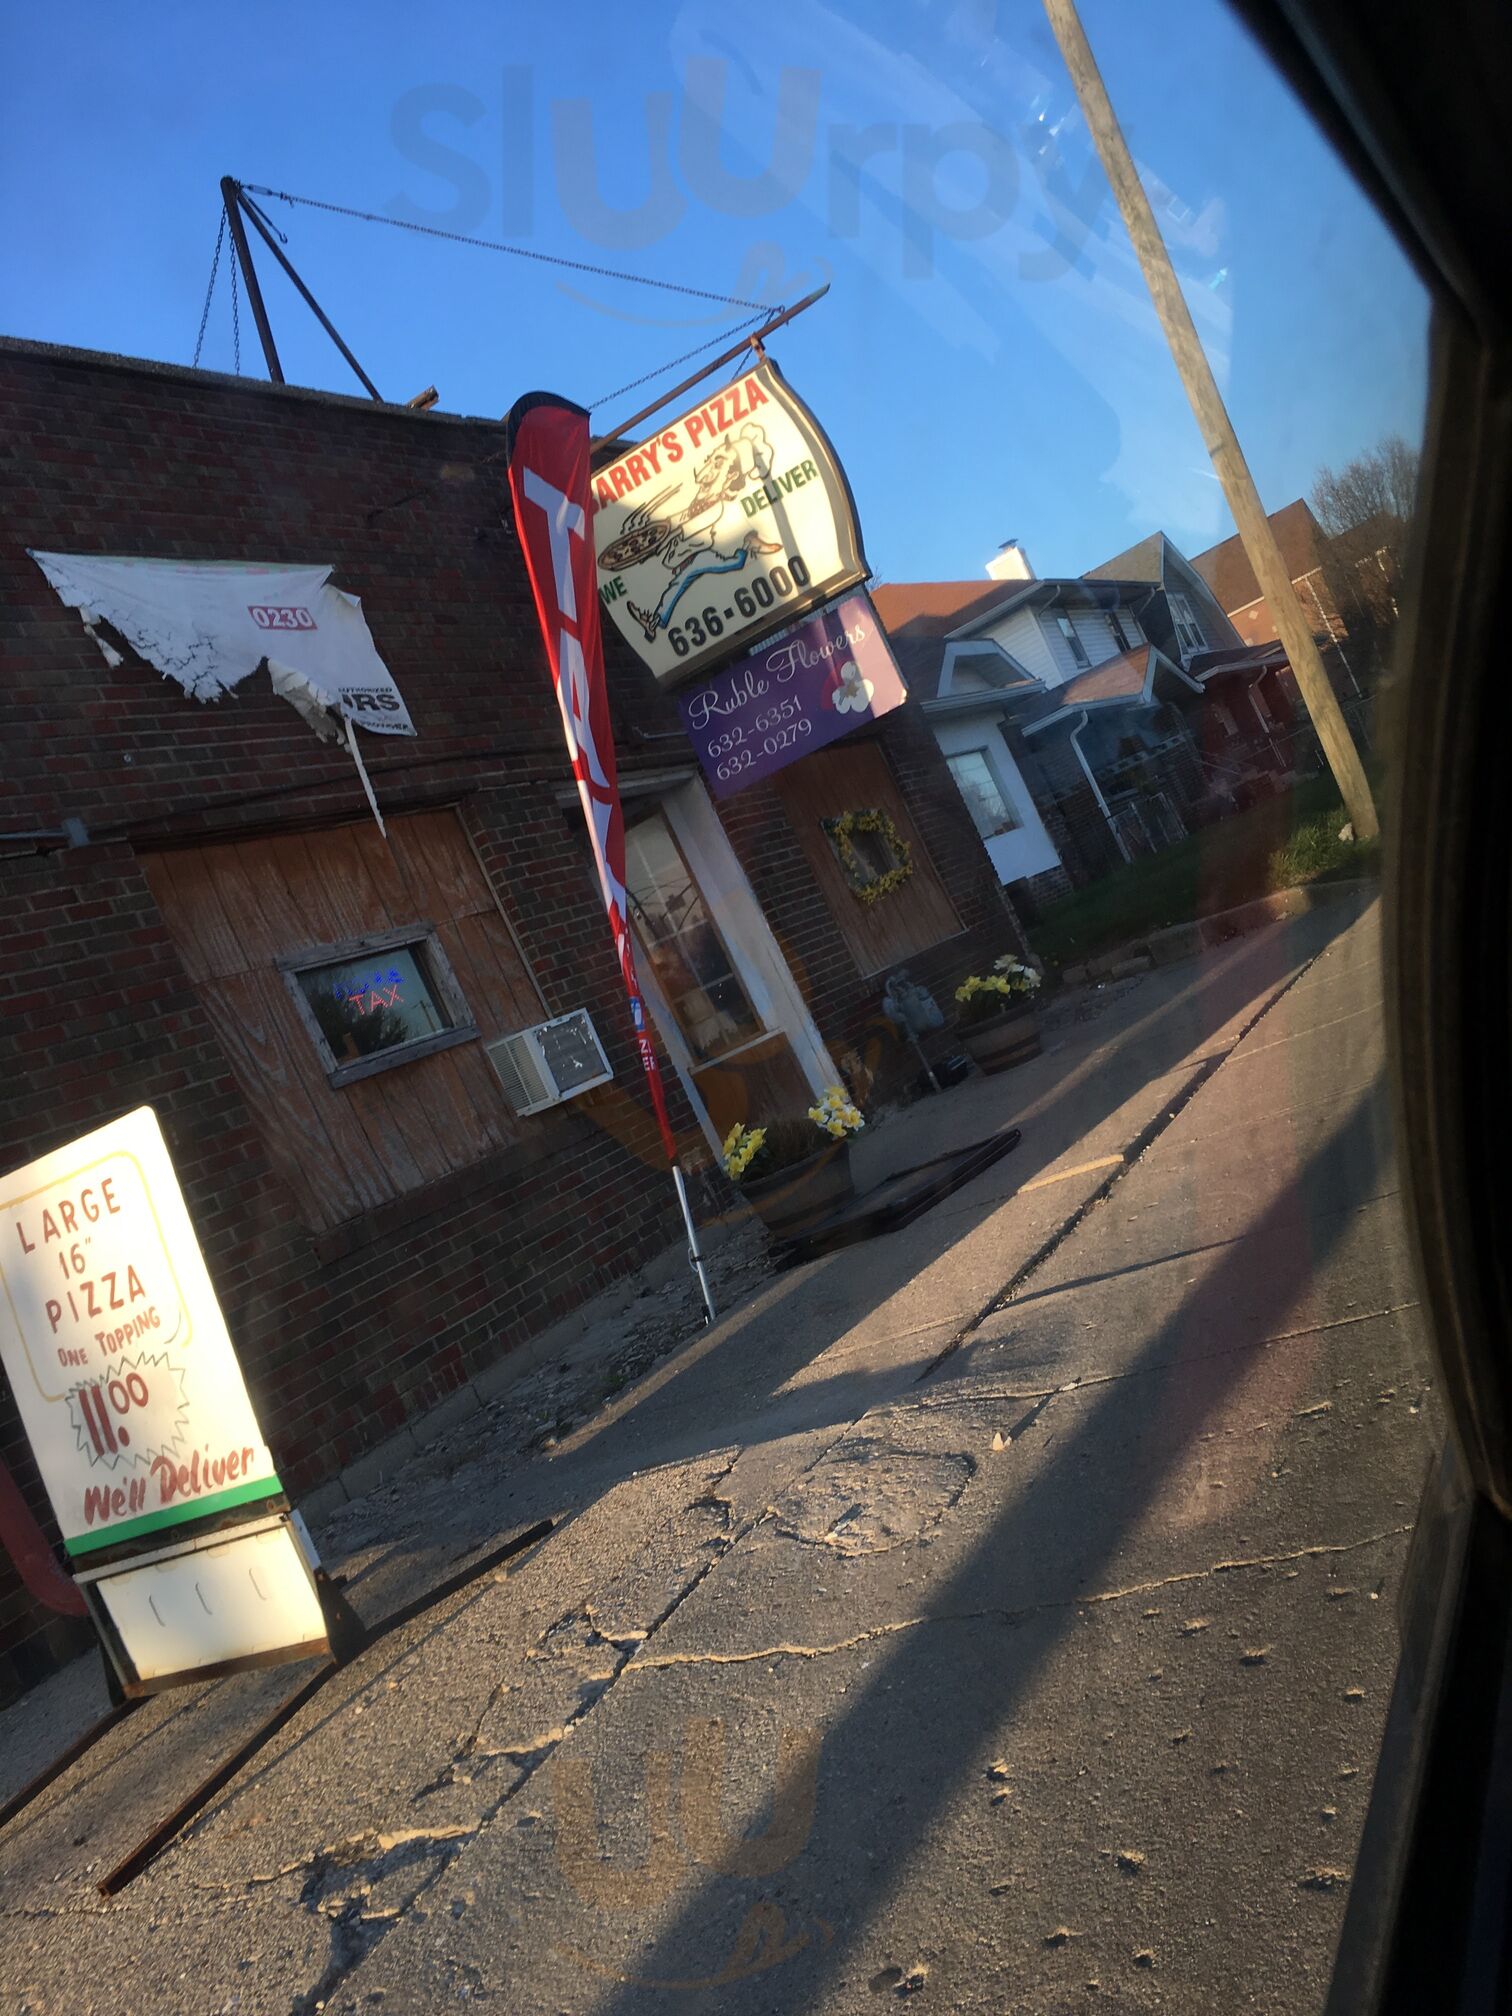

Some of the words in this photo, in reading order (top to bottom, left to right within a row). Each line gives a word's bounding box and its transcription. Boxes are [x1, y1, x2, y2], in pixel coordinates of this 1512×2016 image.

[591, 431, 685, 514] ARRY'S
[684, 376, 770, 449] PIZZA
[739, 458, 819, 519] DELIVER
[252, 607, 313, 629] 0230
[598, 574, 628, 606] WE
[667, 554, 811, 658] 636-6000
[687, 670, 770, 731] Ruble
[765, 624, 867, 684] Flowers
[707, 695, 802, 759] 632-6351
[716, 718, 813, 781] 632-0279
[348, 984, 406, 1016] TAX
[15, 1177, 122, 1255] LARGE
[45, 1264, 147, 1334] PIZZA
[57, 1347, 89, 1368] ONE
[94, 1306, 161, 1357] TOPPING
[149, 1443, 255, 1504] Deliver
